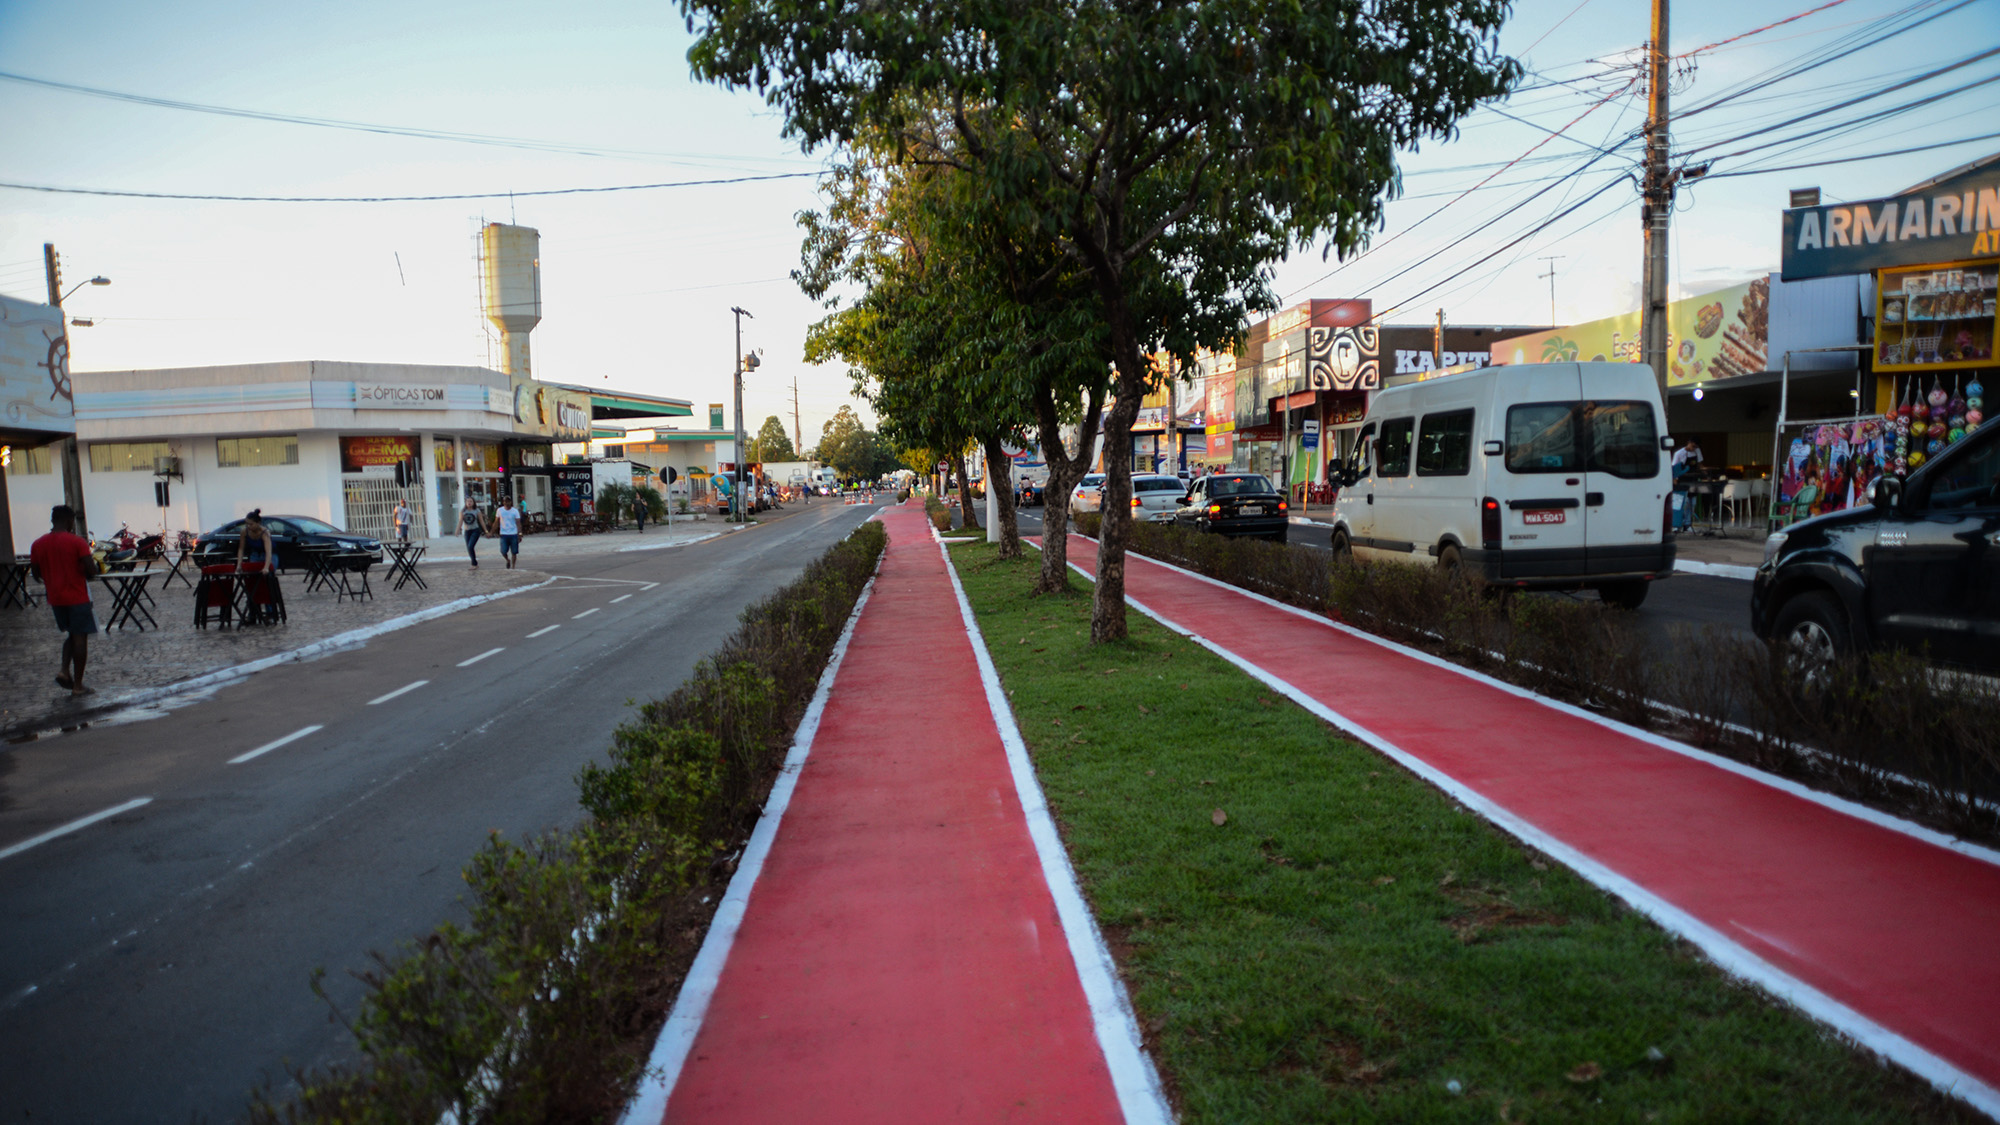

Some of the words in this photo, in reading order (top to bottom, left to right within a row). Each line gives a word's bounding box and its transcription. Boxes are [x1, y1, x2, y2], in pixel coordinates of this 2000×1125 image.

[1395, 349, 1493, 374] KAPIT
[374, 386, 419, 401] ÓPTICAS
[421, 389, 444, 400] TOM
[349, 444, 411, 455] QUEIMA
